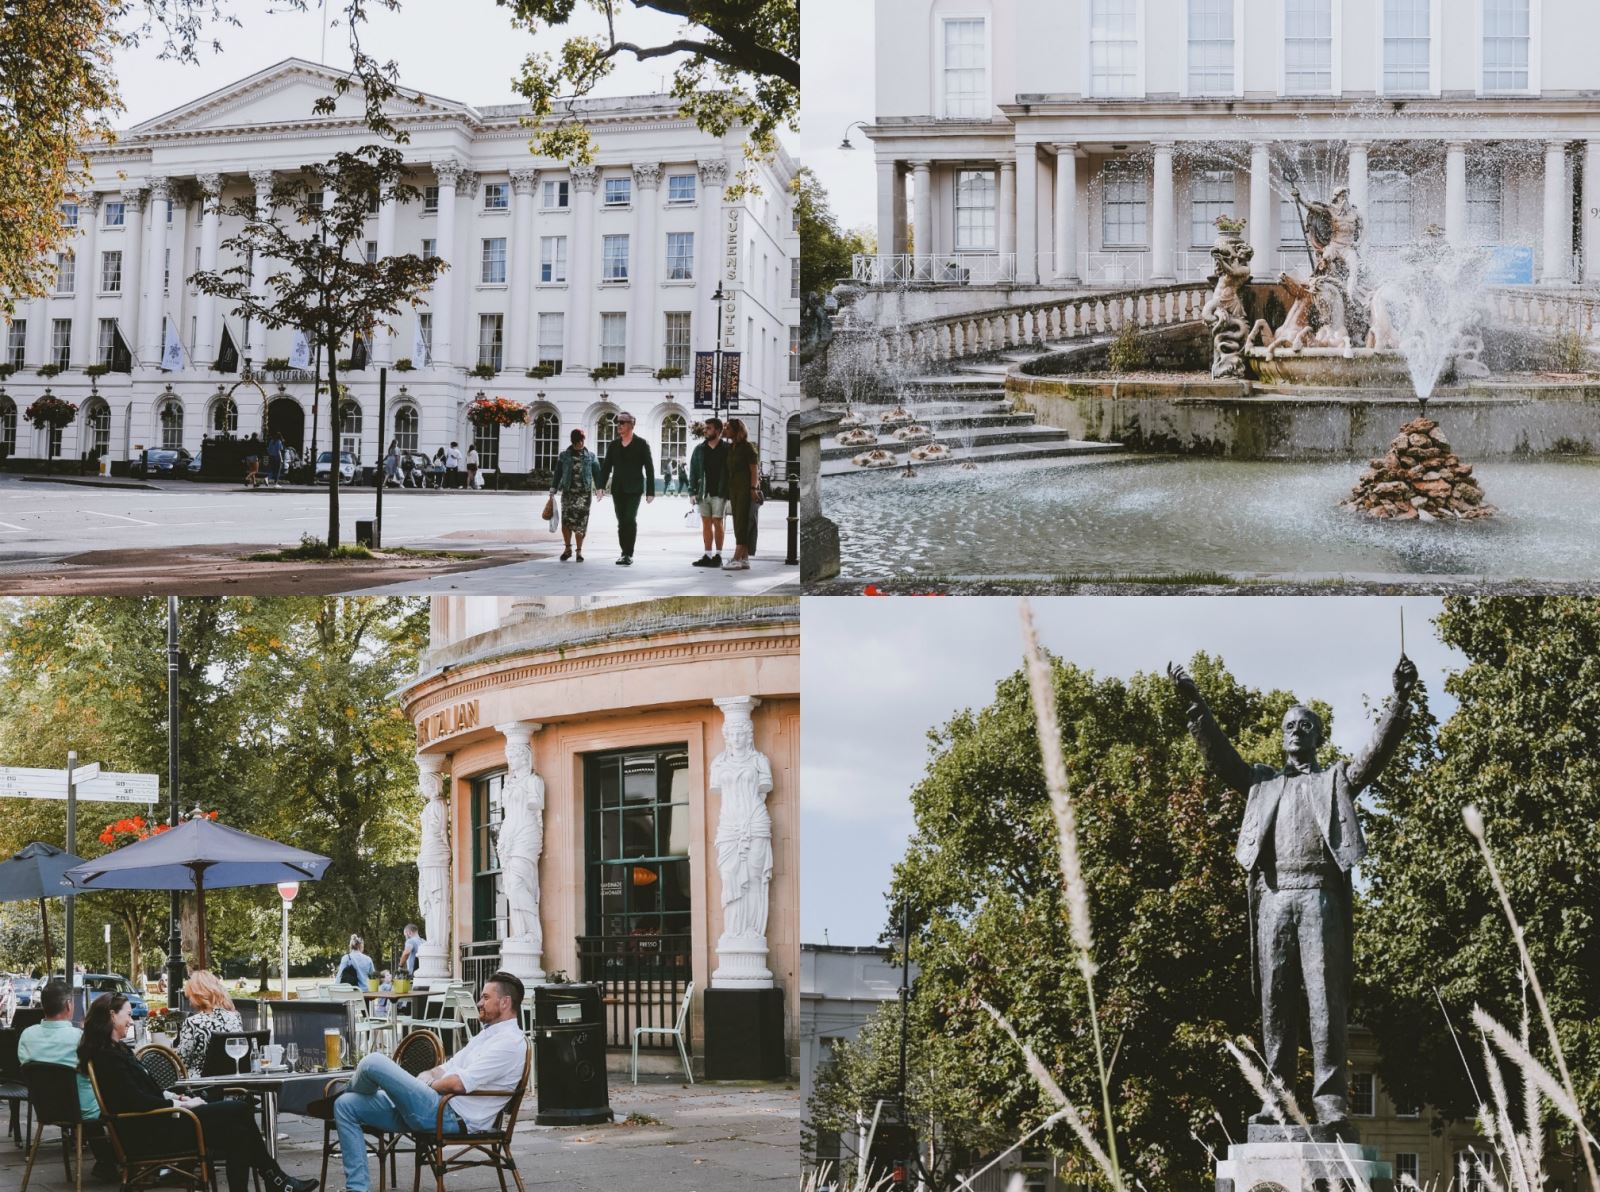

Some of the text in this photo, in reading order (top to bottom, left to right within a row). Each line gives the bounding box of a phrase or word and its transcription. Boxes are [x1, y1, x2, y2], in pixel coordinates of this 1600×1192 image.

[1591, 207, 1600, 219] 9
[723, 207, 739, 348] QUEENS HOTEL
[704, 355, 713, 392] STAY SAFE
